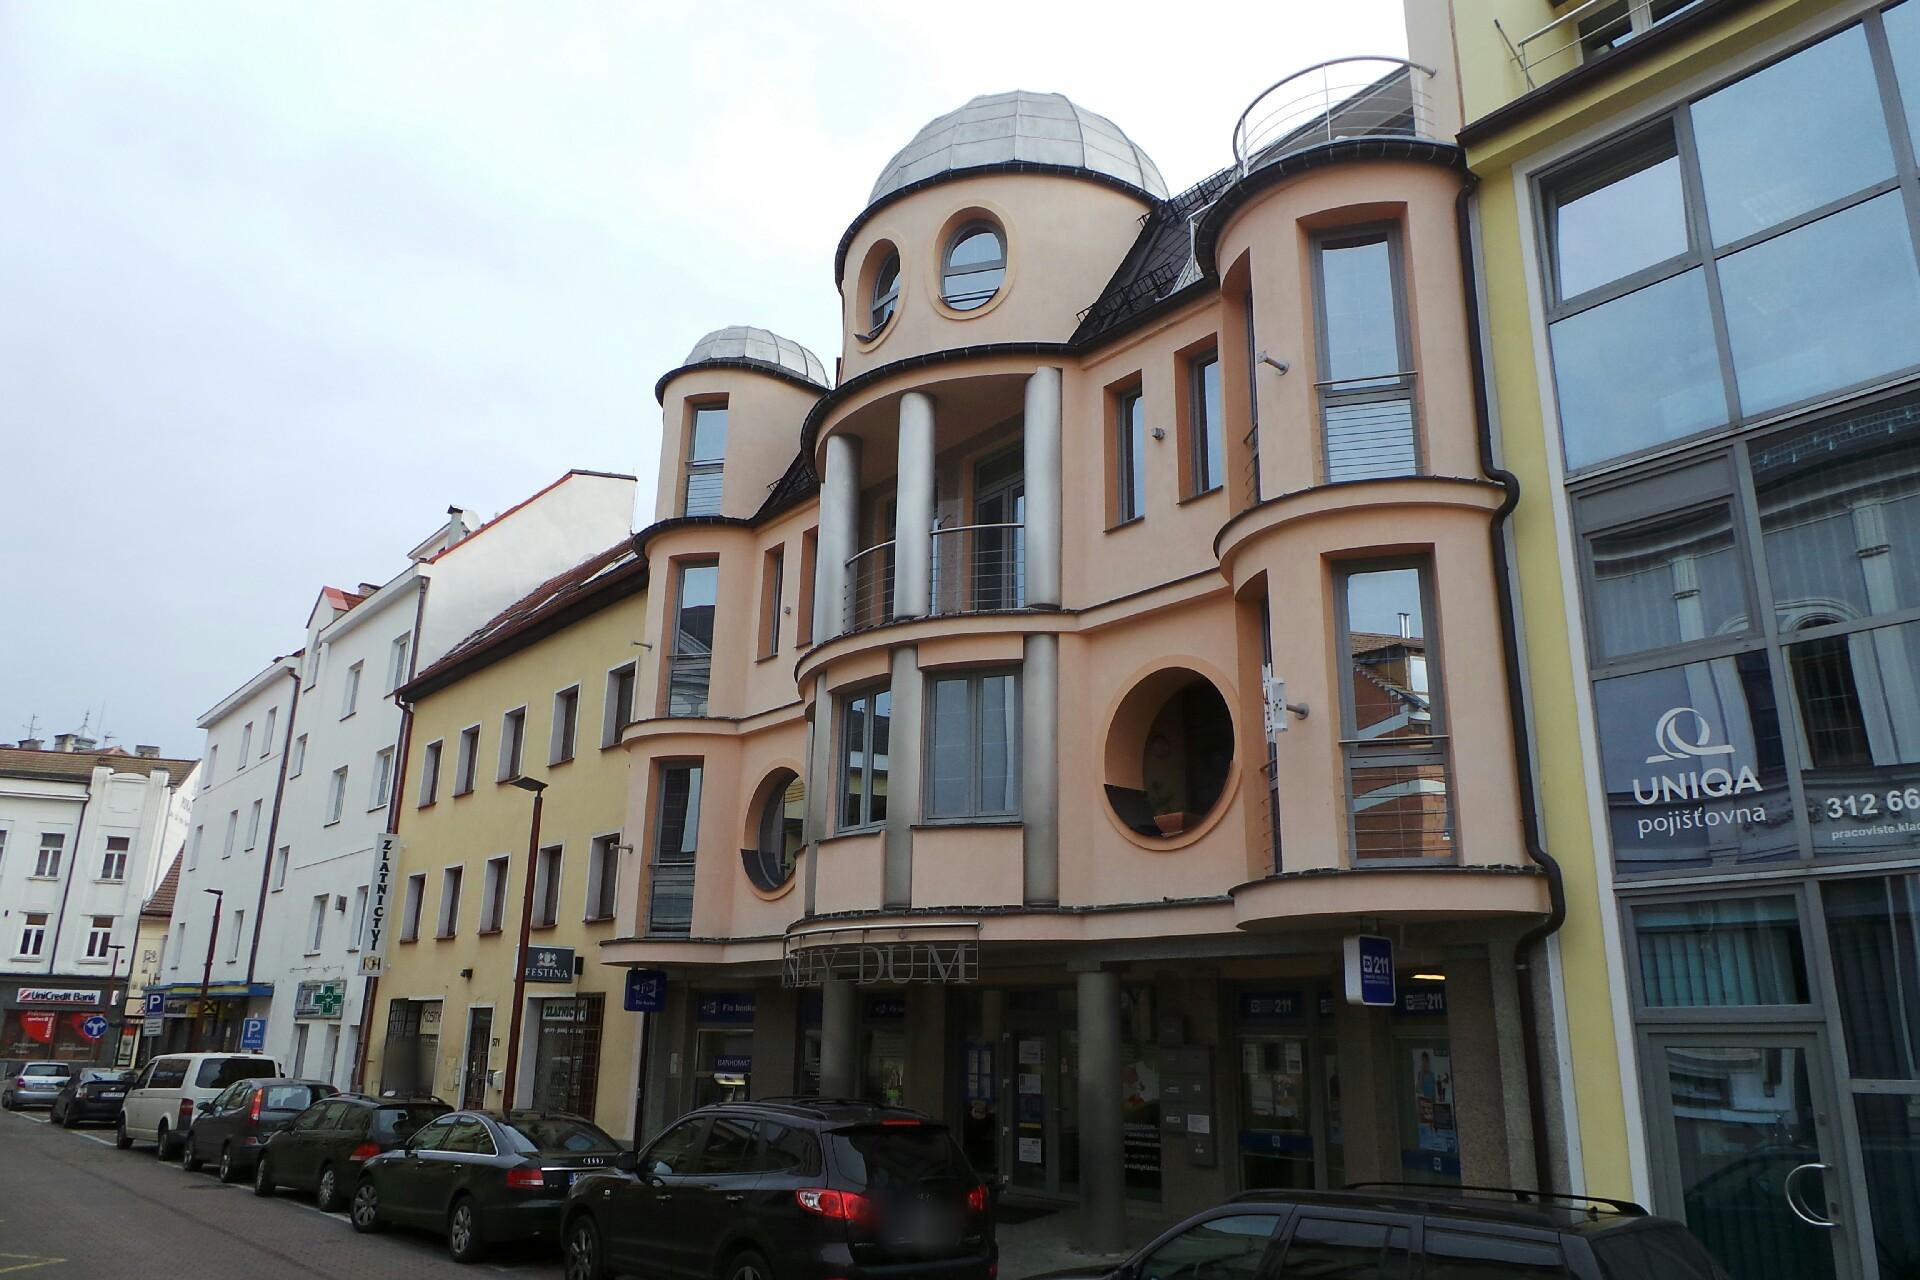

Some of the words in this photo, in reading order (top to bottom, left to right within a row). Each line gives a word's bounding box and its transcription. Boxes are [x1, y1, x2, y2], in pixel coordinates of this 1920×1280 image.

[1632, 765, 1764, 806] UNIQA
[1826, 793, 1878, 819] 312
[1637, 805, 1767, 838] pojišťovna
[525, 967, 569, 979] FESTINA
[1373, 955, 1390, 974] 211
[31, 991, 71, 1001] UniCredit
[73, 992, 97, 1002] Bank
[149, 994, 161, 1010] P
[1427, 992, 1443, 1009] 211
[1274, 999, 1292, 1013] 211
[247, 1020, 261, 1038] P
